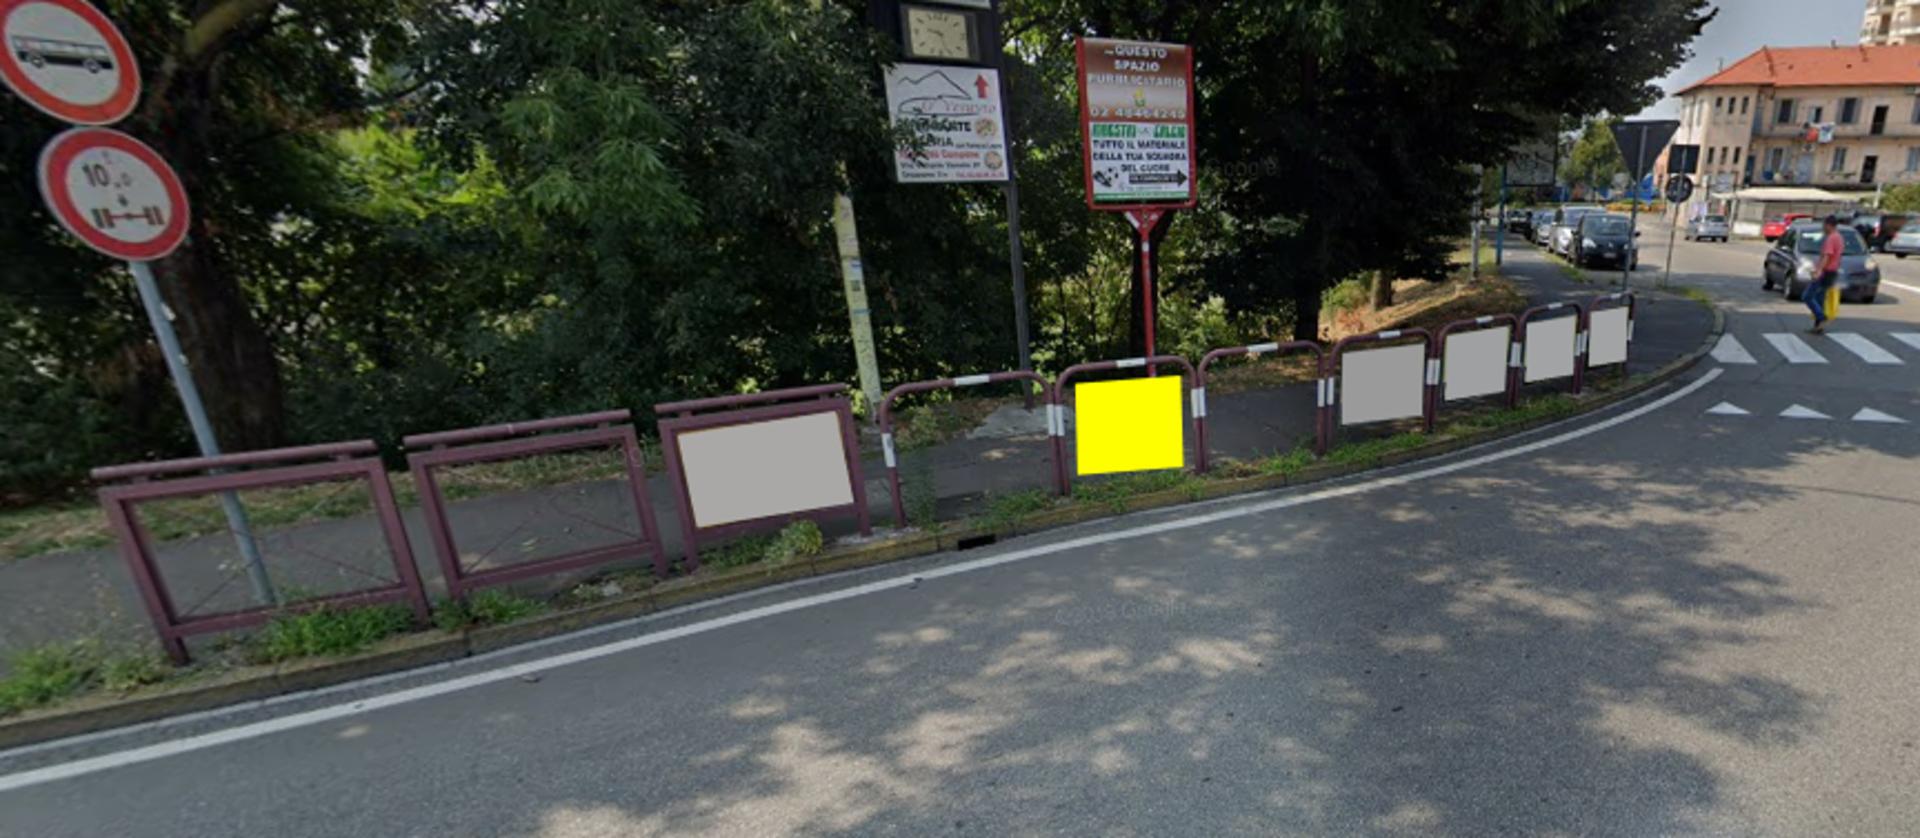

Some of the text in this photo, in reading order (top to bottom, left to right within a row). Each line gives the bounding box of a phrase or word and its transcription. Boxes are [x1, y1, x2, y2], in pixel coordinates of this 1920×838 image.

[1114, 60, 1160, 71] SPAZIO
[1087, 73, 1185, 87] PUBBLICITARIO
[1093, 140, 1185, 150] TUTTO IL MATERIALE
[1093, 152, 1187, 161] DELLA TUA SQUADRA
[1121, 164, 1170, 172] DEL CUORE
